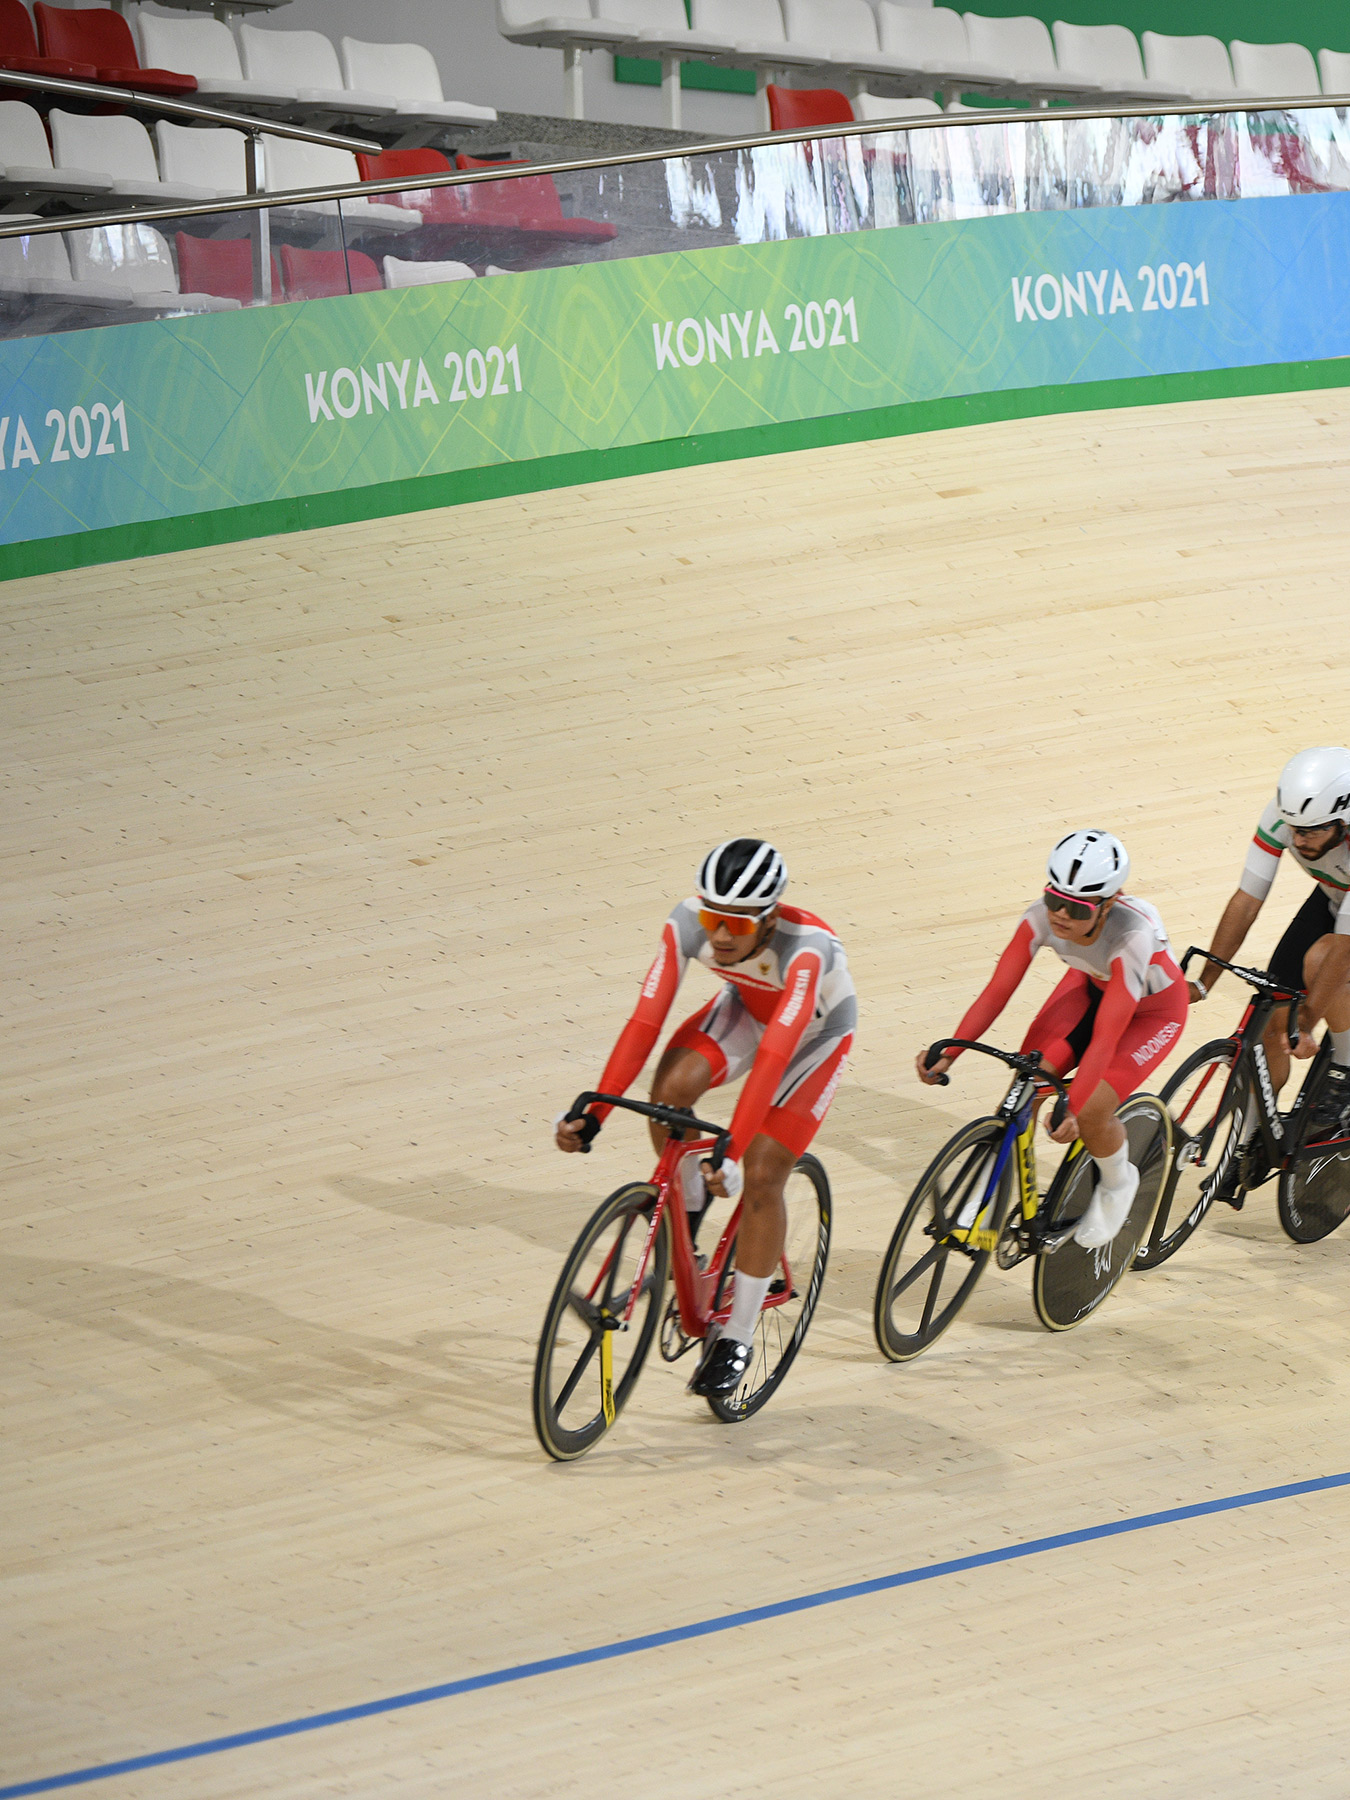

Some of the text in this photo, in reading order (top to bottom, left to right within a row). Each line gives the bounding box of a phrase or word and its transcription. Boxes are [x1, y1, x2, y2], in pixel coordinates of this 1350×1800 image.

[1011, 260, 1210, 324] KONYA 2021
[651, 295, 861, 372] KONYA 2021
[304, 343, 524, 424] KONYA 2021
[45, 399, 130, 463] 2021
[777, 968, 812, 1027] INDONESIA
[1130, 1021, 1182, 1067] INDONESIA
[1002, 1079, 1026, 1110] LOOK
